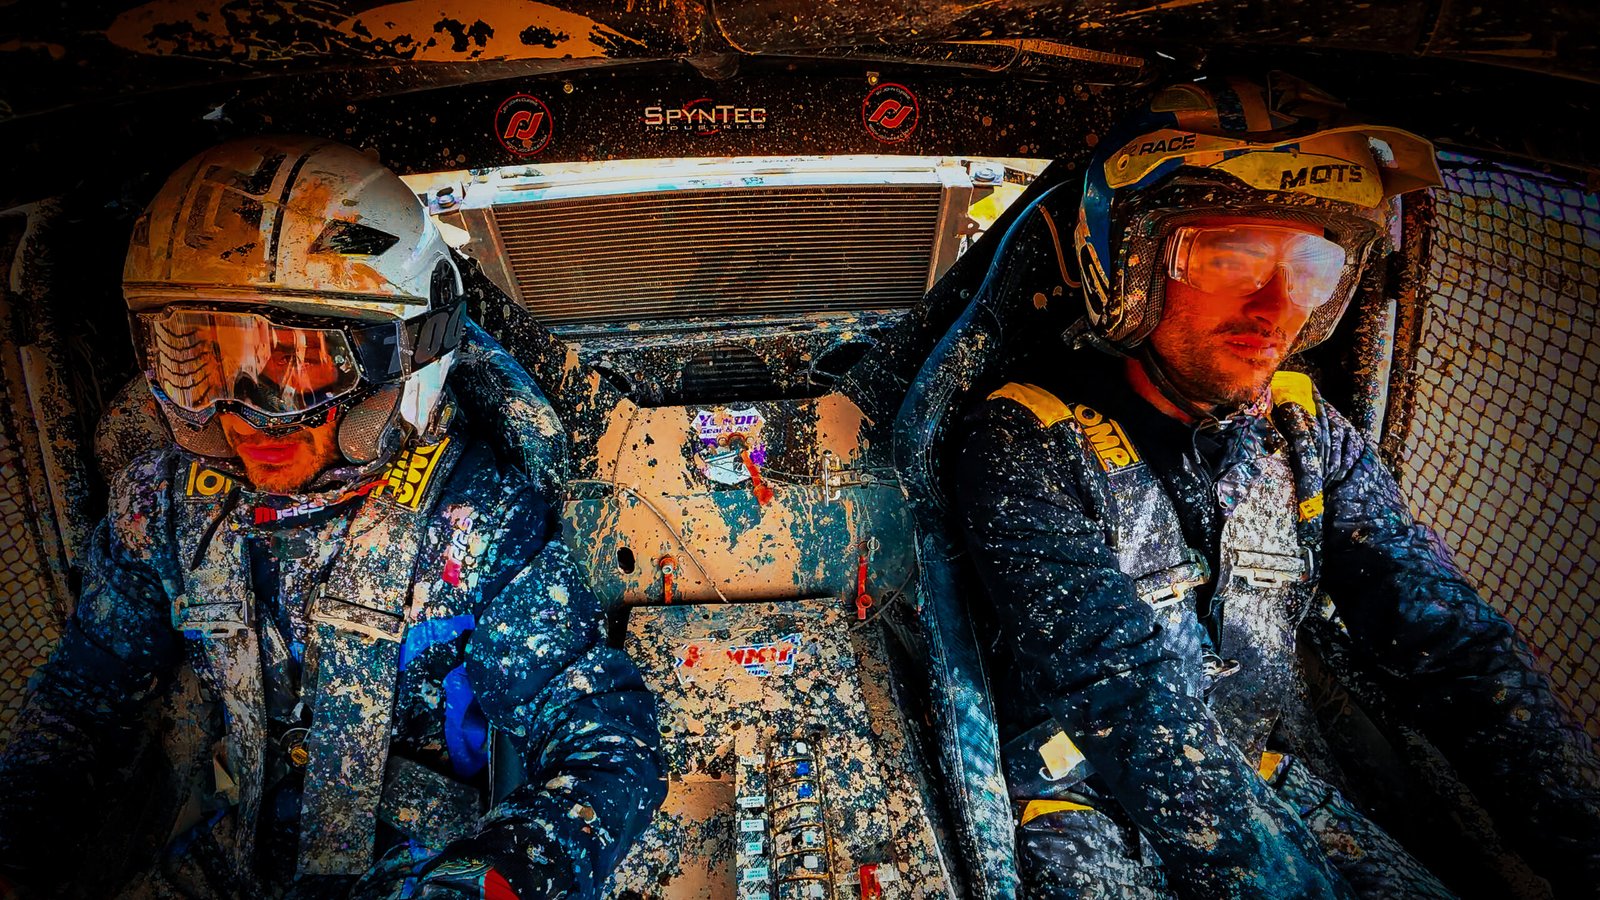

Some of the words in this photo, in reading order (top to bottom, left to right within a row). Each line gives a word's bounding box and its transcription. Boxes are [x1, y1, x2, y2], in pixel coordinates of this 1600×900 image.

[645, 124, 765, 132] INDUSTRIES
[1139, 133, 1197, 156] RACE
[1074, 403, 1131, 467] OMP
